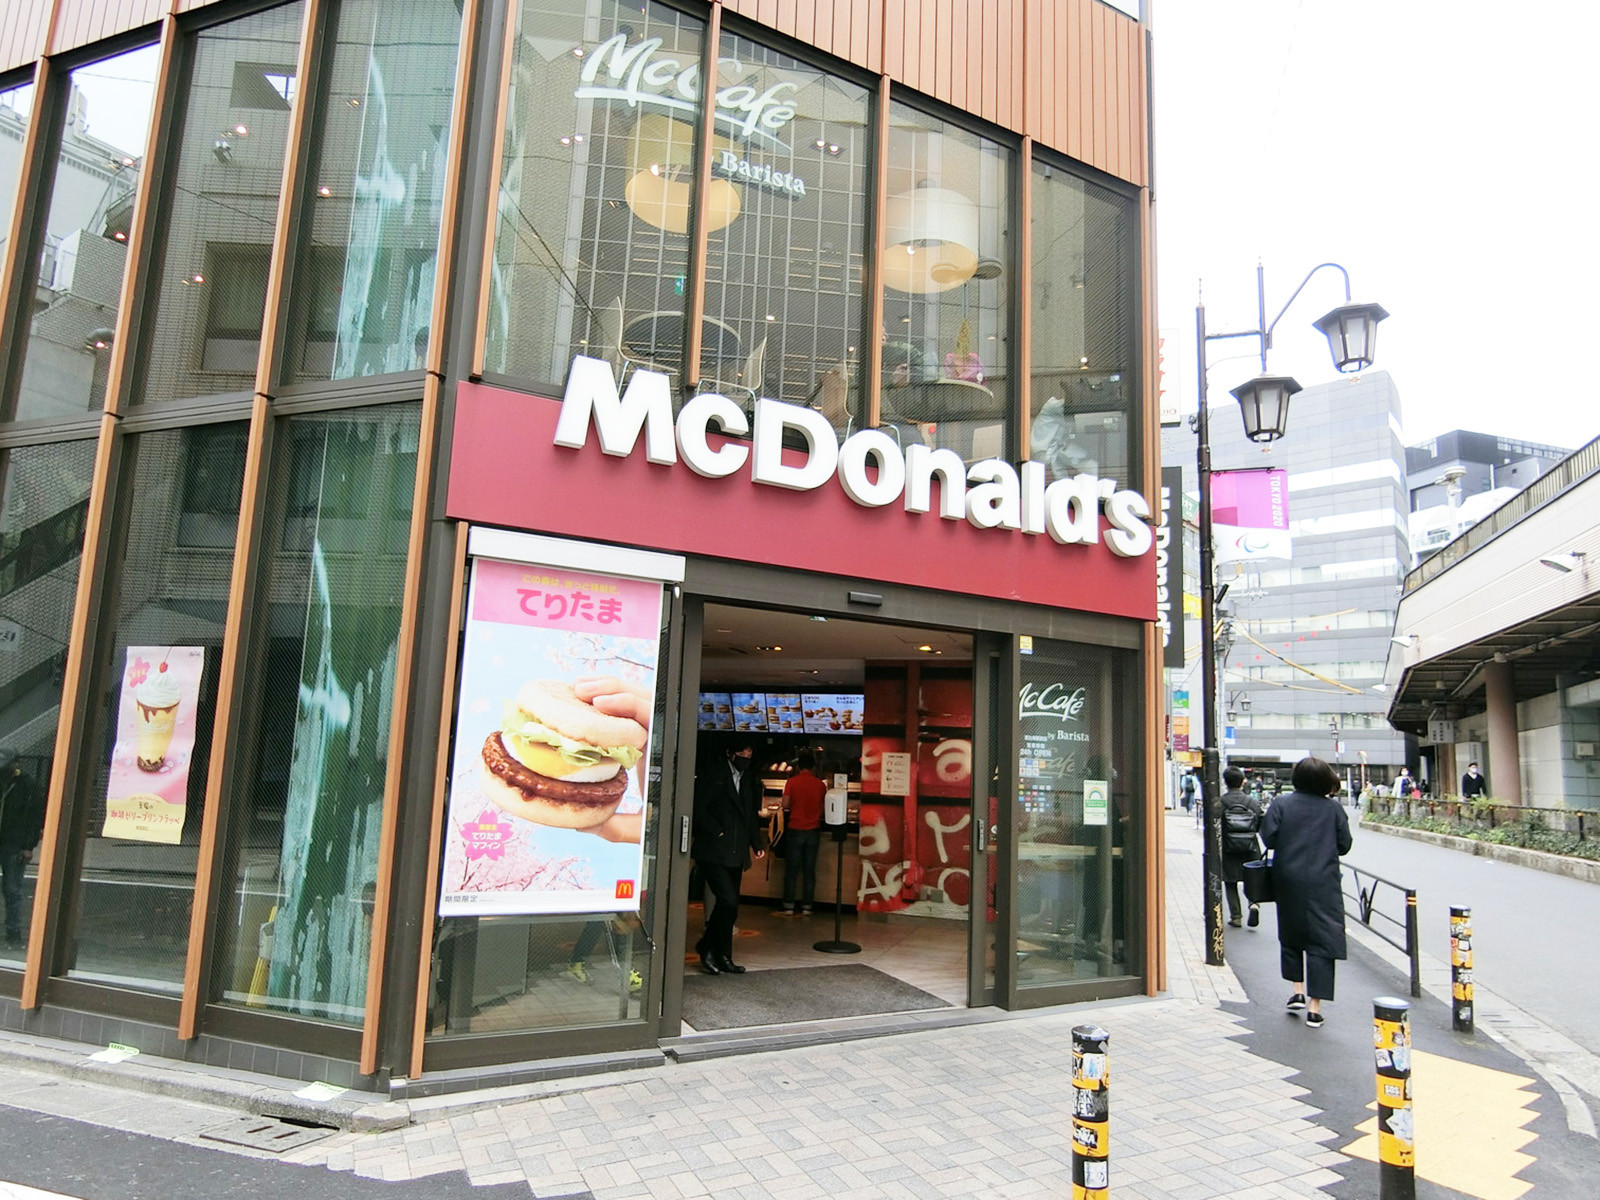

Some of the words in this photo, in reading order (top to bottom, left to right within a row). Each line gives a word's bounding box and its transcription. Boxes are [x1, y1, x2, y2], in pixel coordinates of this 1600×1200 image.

[577, 33, 798, 138] McCafé
[720, 151, 807, 196] Barista
[552, 354, 1153, 558] McDonald's
[1269, 475, 1281, 504] TOKYO
[1272, 505, 1284, 527] 2020
[516, 588, 623, 624] てりたま
[1057, 730, 1089, 742] Barista
[1033, 749, 1052, 758] OPEN
[471, 832, 502, 841] てりたま
[472, 841, 501, 850] マフィン
